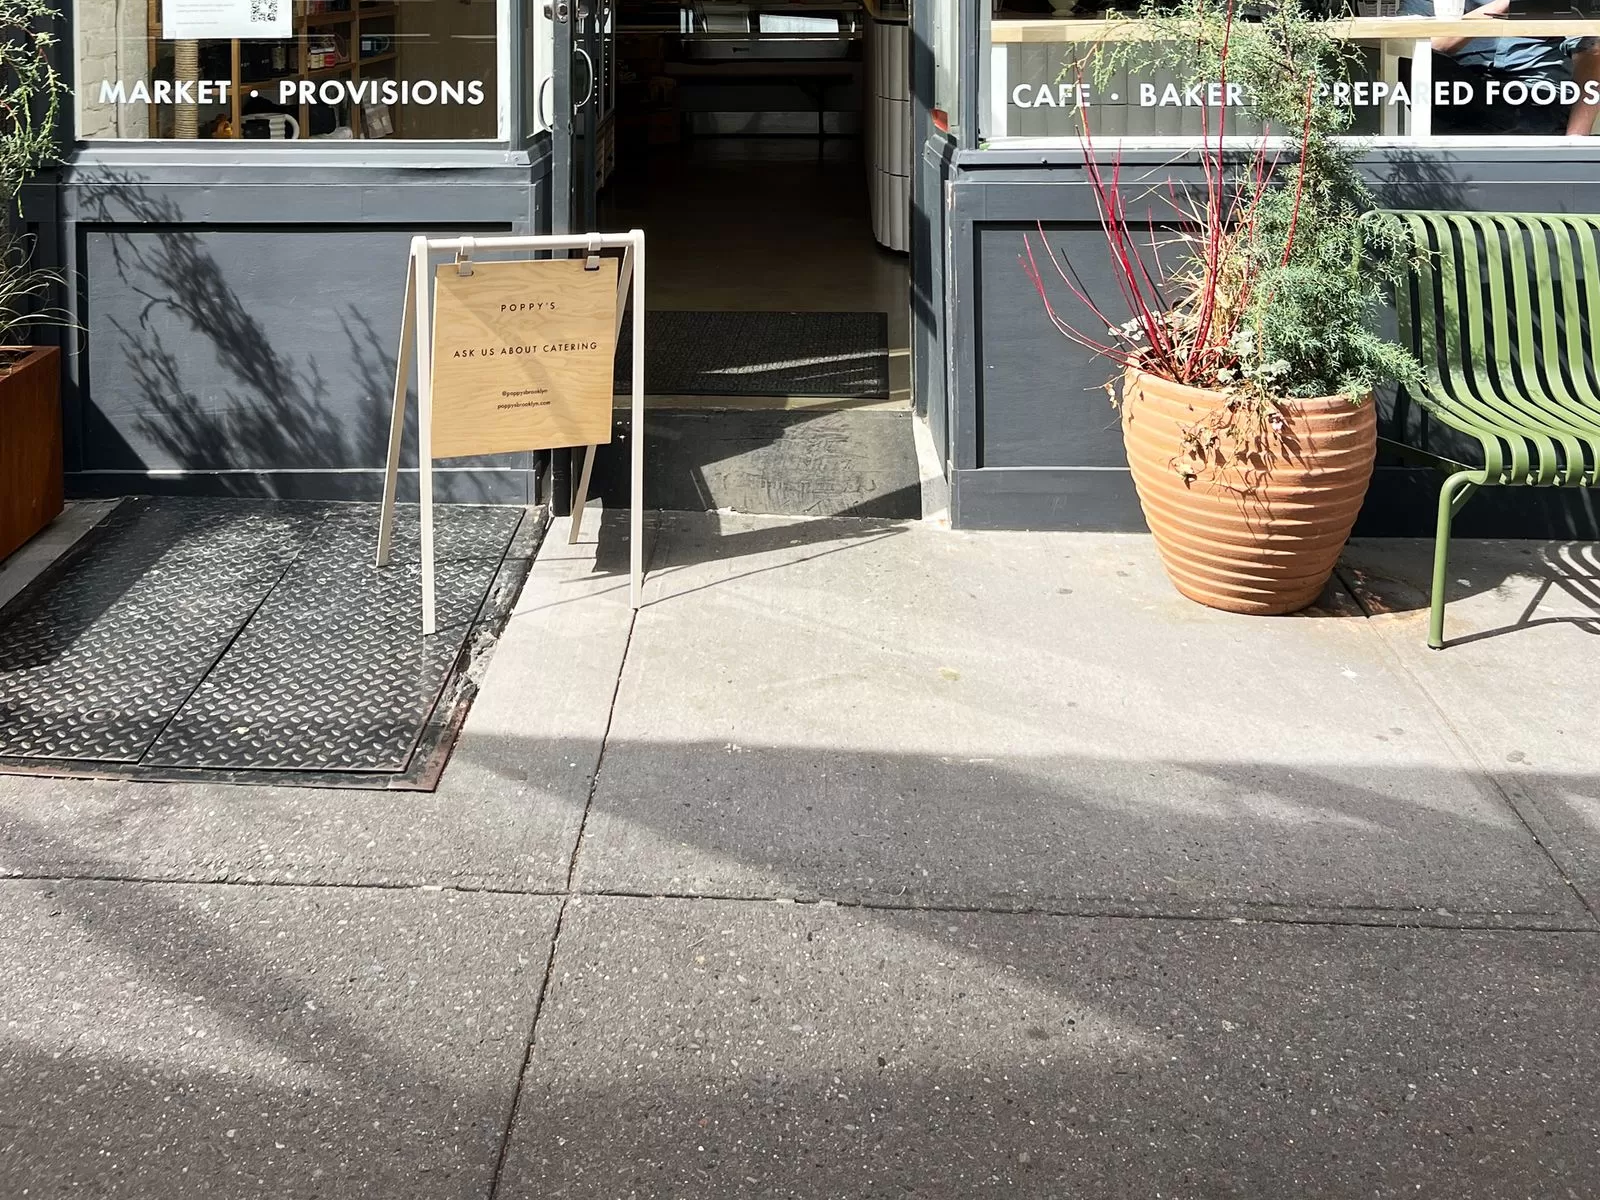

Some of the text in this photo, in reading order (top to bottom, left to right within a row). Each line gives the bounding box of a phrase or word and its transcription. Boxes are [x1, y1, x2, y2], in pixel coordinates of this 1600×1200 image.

[98, 79, 485, 105] MARKET PROVISIONS
[1012, 83, 1091, 108] CAFE
[1486, 80, 1600, 105] FOODS
[500, 301, 556, 312] POPPY'S
[453, 341, 598, 359] ASK US ABOUT CATERING
[502, 387, 548, 398] @poppysbrooklyn
[497, 400, 551, 410] poppysbrooklyn.com
